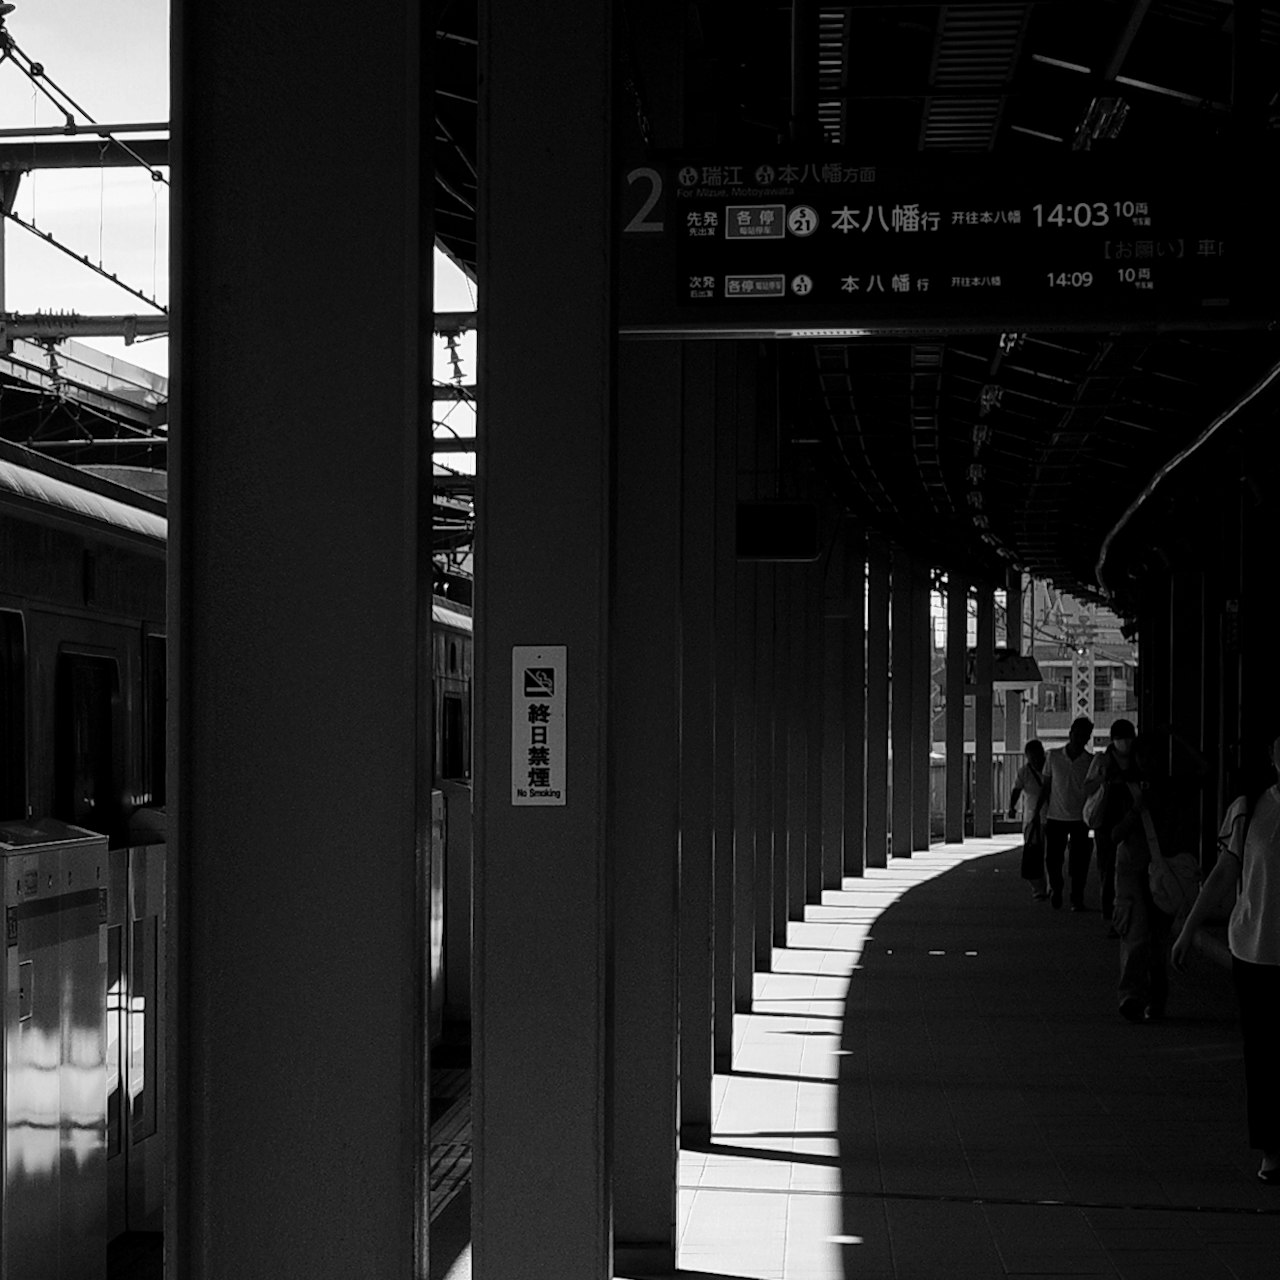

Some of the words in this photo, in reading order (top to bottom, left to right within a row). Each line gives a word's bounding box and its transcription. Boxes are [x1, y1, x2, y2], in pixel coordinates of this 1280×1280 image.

[701, 165, 744, 186] 瑞江
[777, 162, 877, 185] 本八幡方面
[623, 167, 665, 232] 2
[677, 188, 691, 198] For
[731, 186, 795, 199] Motoyawata
[686, 211, 718, 227] 先発
[736, 209, 775, 225] 各停
[831, 203, 941, 234] 本八幡行
[1032, 202, 1110, 227] 14:03
[794, 219, 811, 231] 21
[688, 275, 715, 288] 次発
[1046, 271, 1093, 288] 14:09
[527, 703, 551, 787] 終日禁煙
[517, 788, 527, 797] No
[529, 788, 561, 799] Smoking
